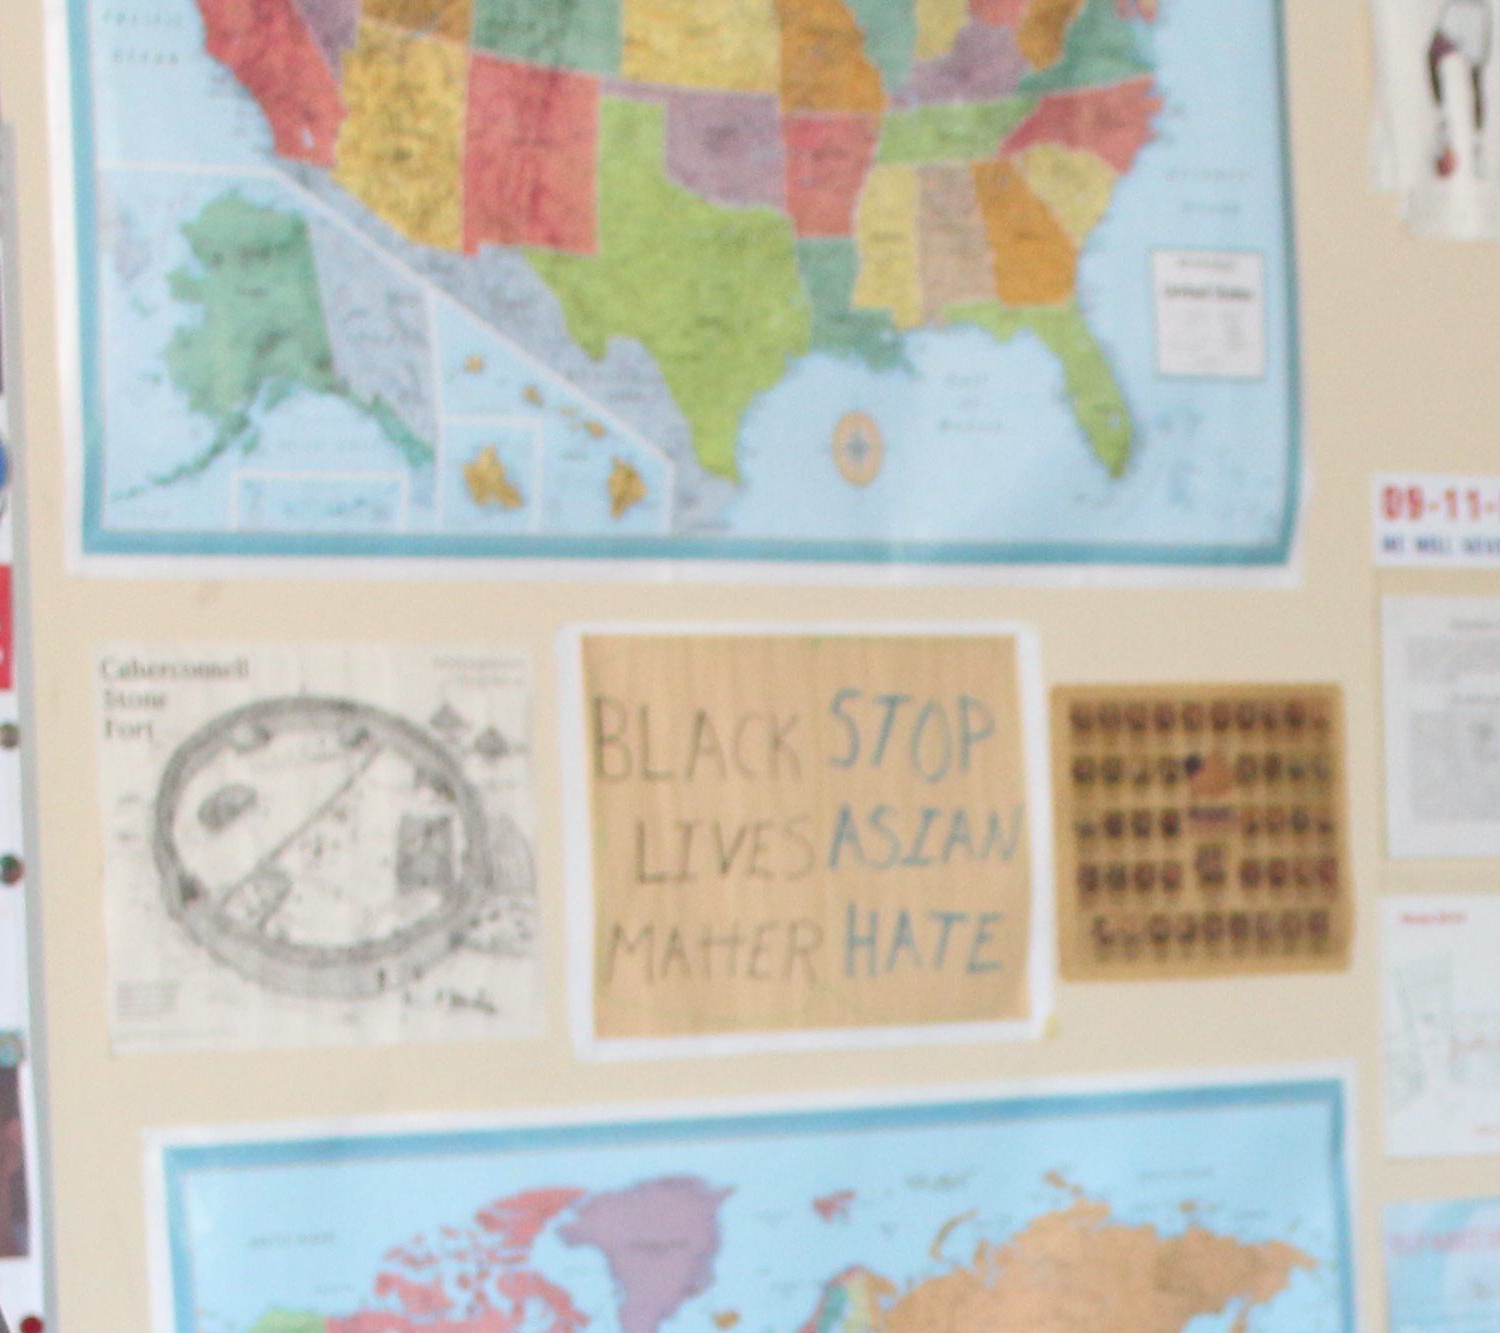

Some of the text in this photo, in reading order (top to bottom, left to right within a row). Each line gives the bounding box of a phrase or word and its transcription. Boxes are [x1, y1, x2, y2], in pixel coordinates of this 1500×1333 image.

[103, 690, 168, 712] Stone
[103, 716, 155, 741] Fort
[827, 688, 997, 783] STOP
[593, 695, 802, 783] BLACK
[634, 813, 817, 885] LIVES
[827, 802, 1027, 870] ASIAN
[844, 900, 1005, 978] HATE
